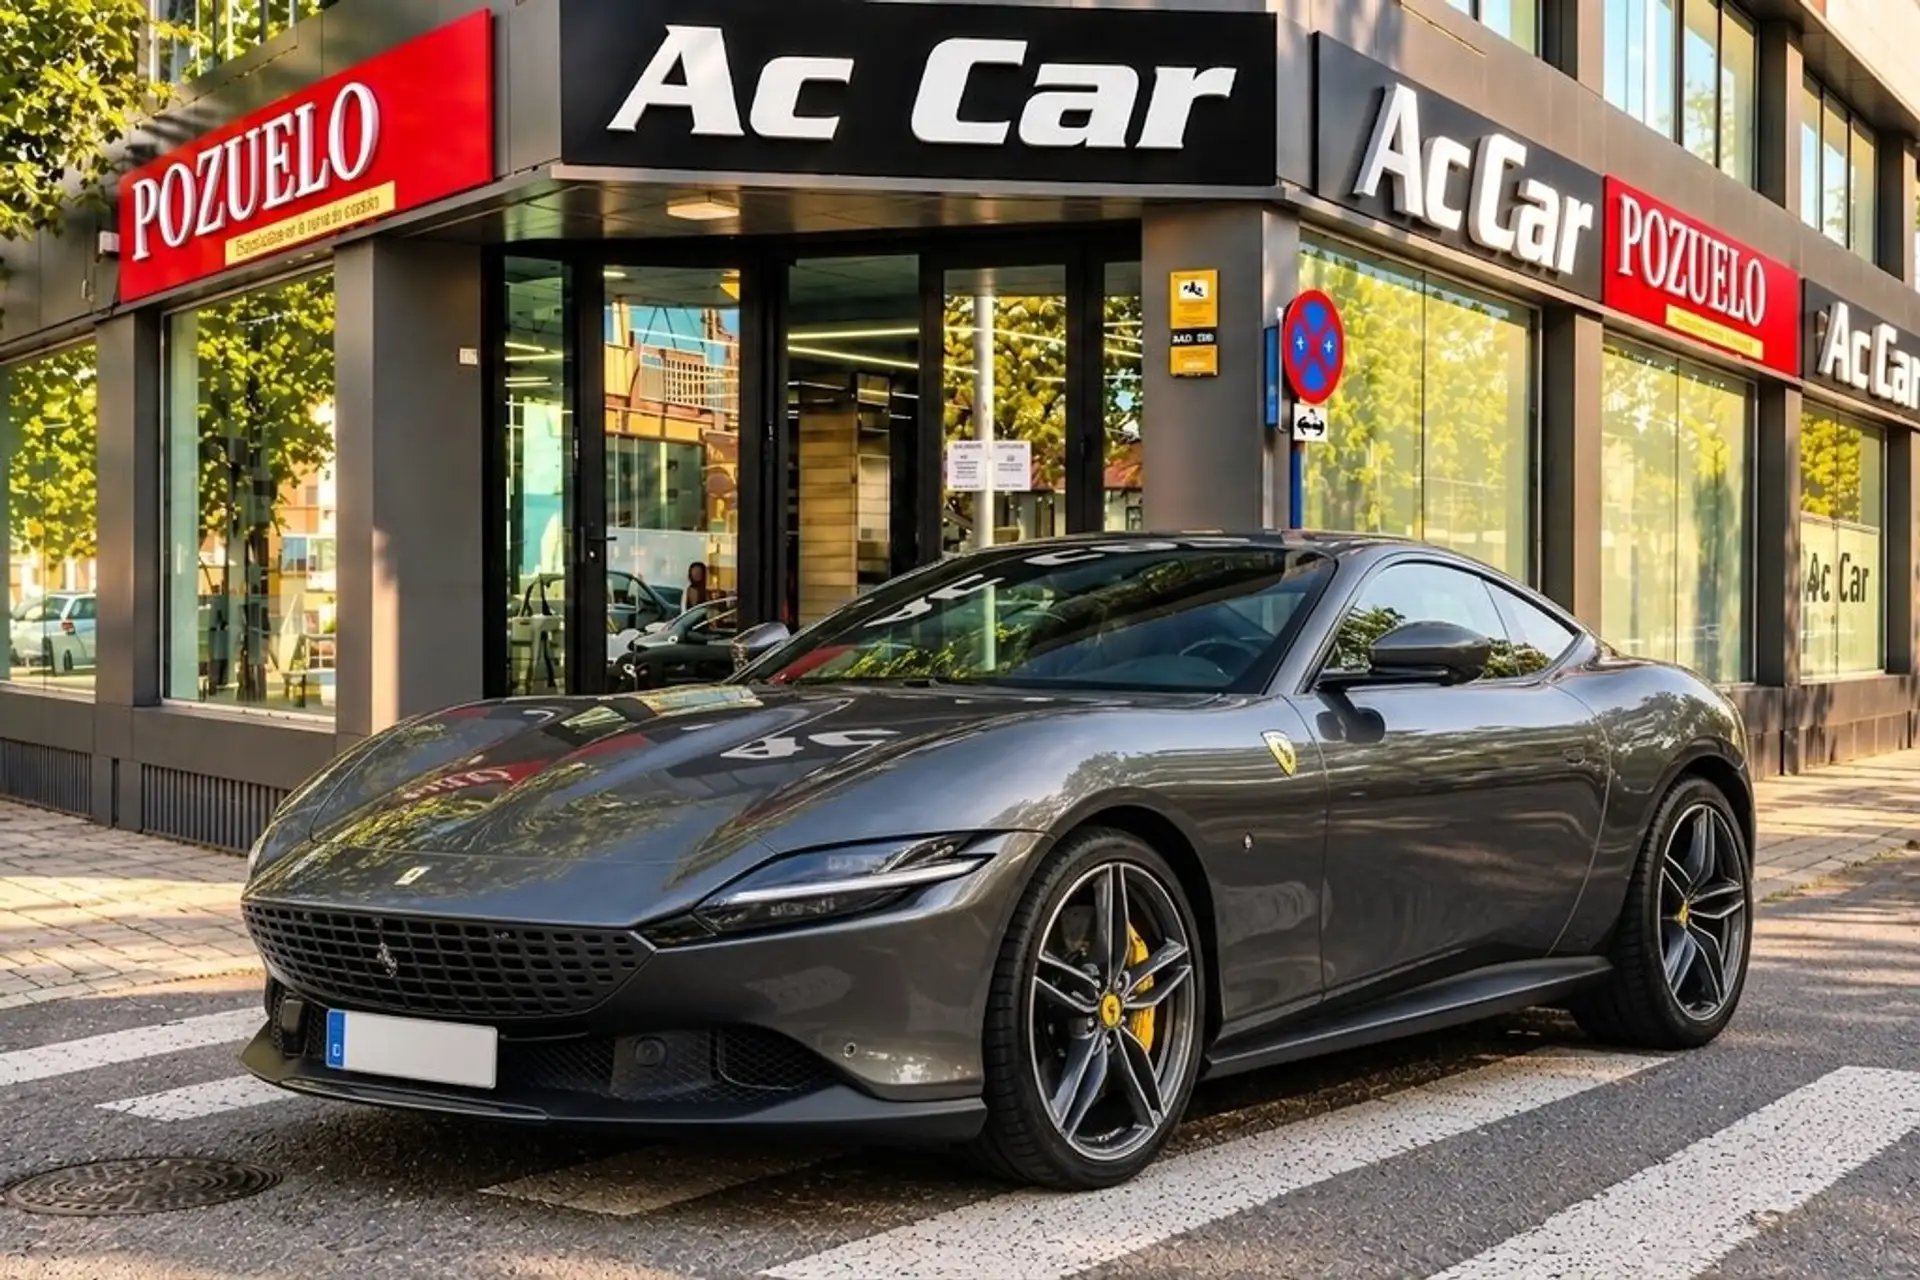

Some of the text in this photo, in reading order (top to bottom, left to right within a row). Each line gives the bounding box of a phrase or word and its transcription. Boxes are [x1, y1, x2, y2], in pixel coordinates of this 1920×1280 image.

[606, 24, 1237, 149] Ac Car
[131, 81, 380, 262] POZUELO
[1617, 193, 1767, 328] POZUELO
[1806, 552, 1869, 603] Ac Car
